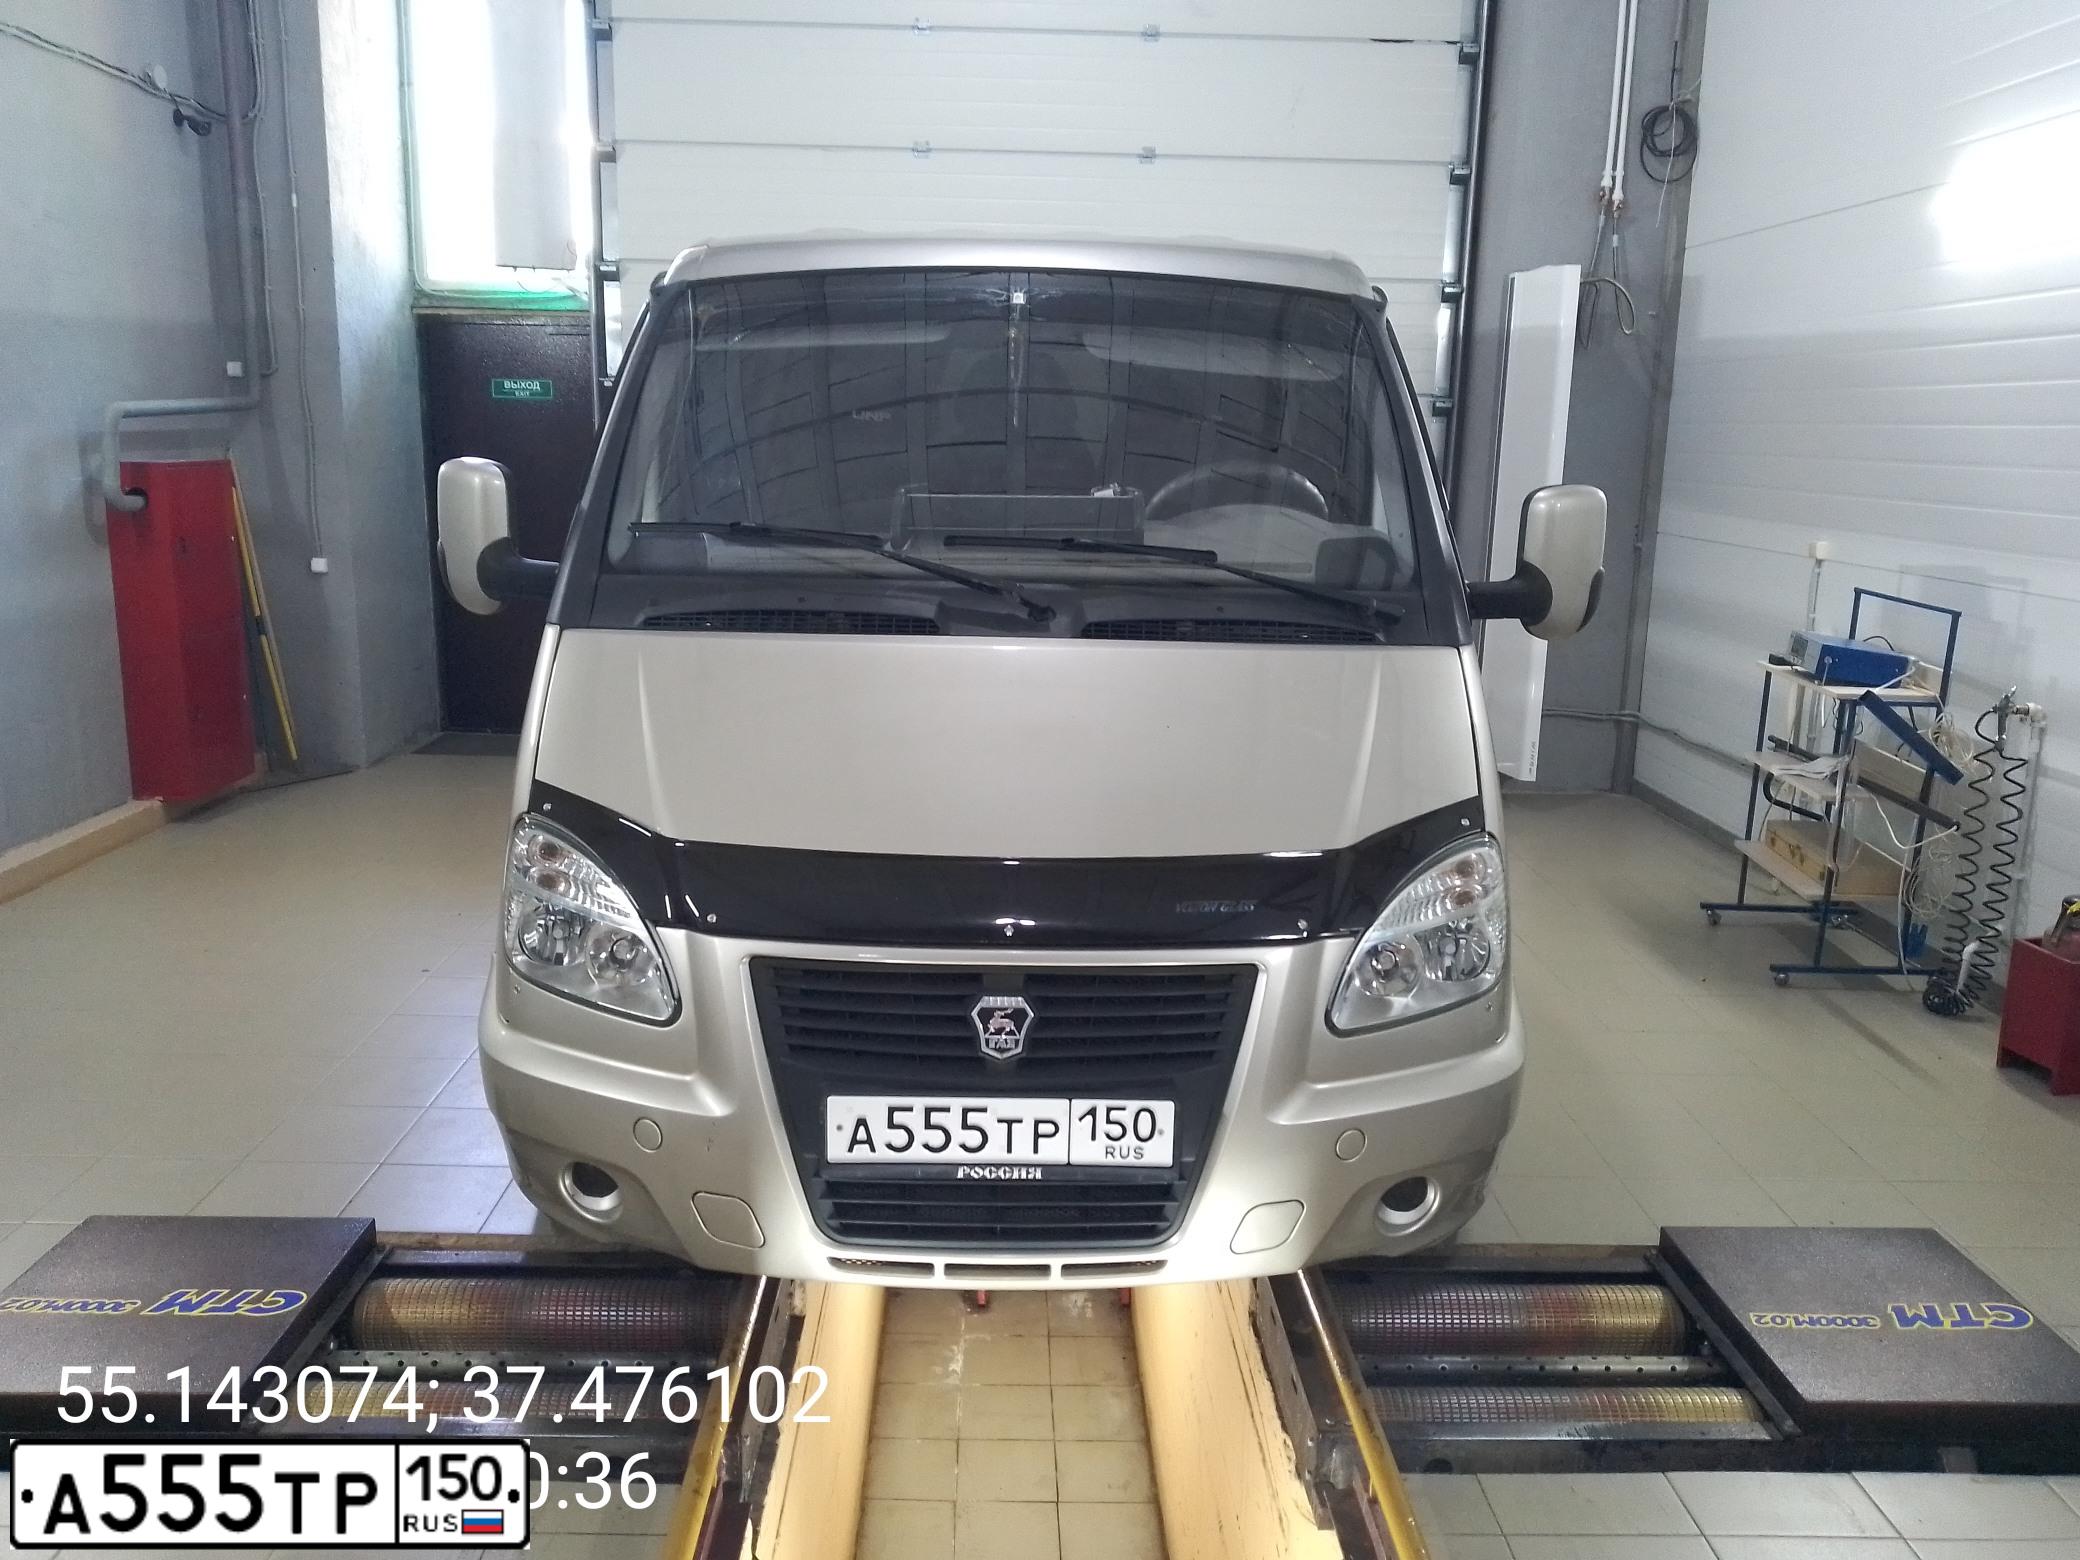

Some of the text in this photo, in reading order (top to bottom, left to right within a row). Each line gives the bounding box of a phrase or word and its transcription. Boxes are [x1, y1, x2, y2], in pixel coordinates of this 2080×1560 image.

[503, 380, 541, 391] ВЫХОД
[846, 1105, 1157, 1154] А555ТР 150
[1104, 1146, 1145, 1161] RUS
[955, 1165, 1043, 1181] РОССИЯ
